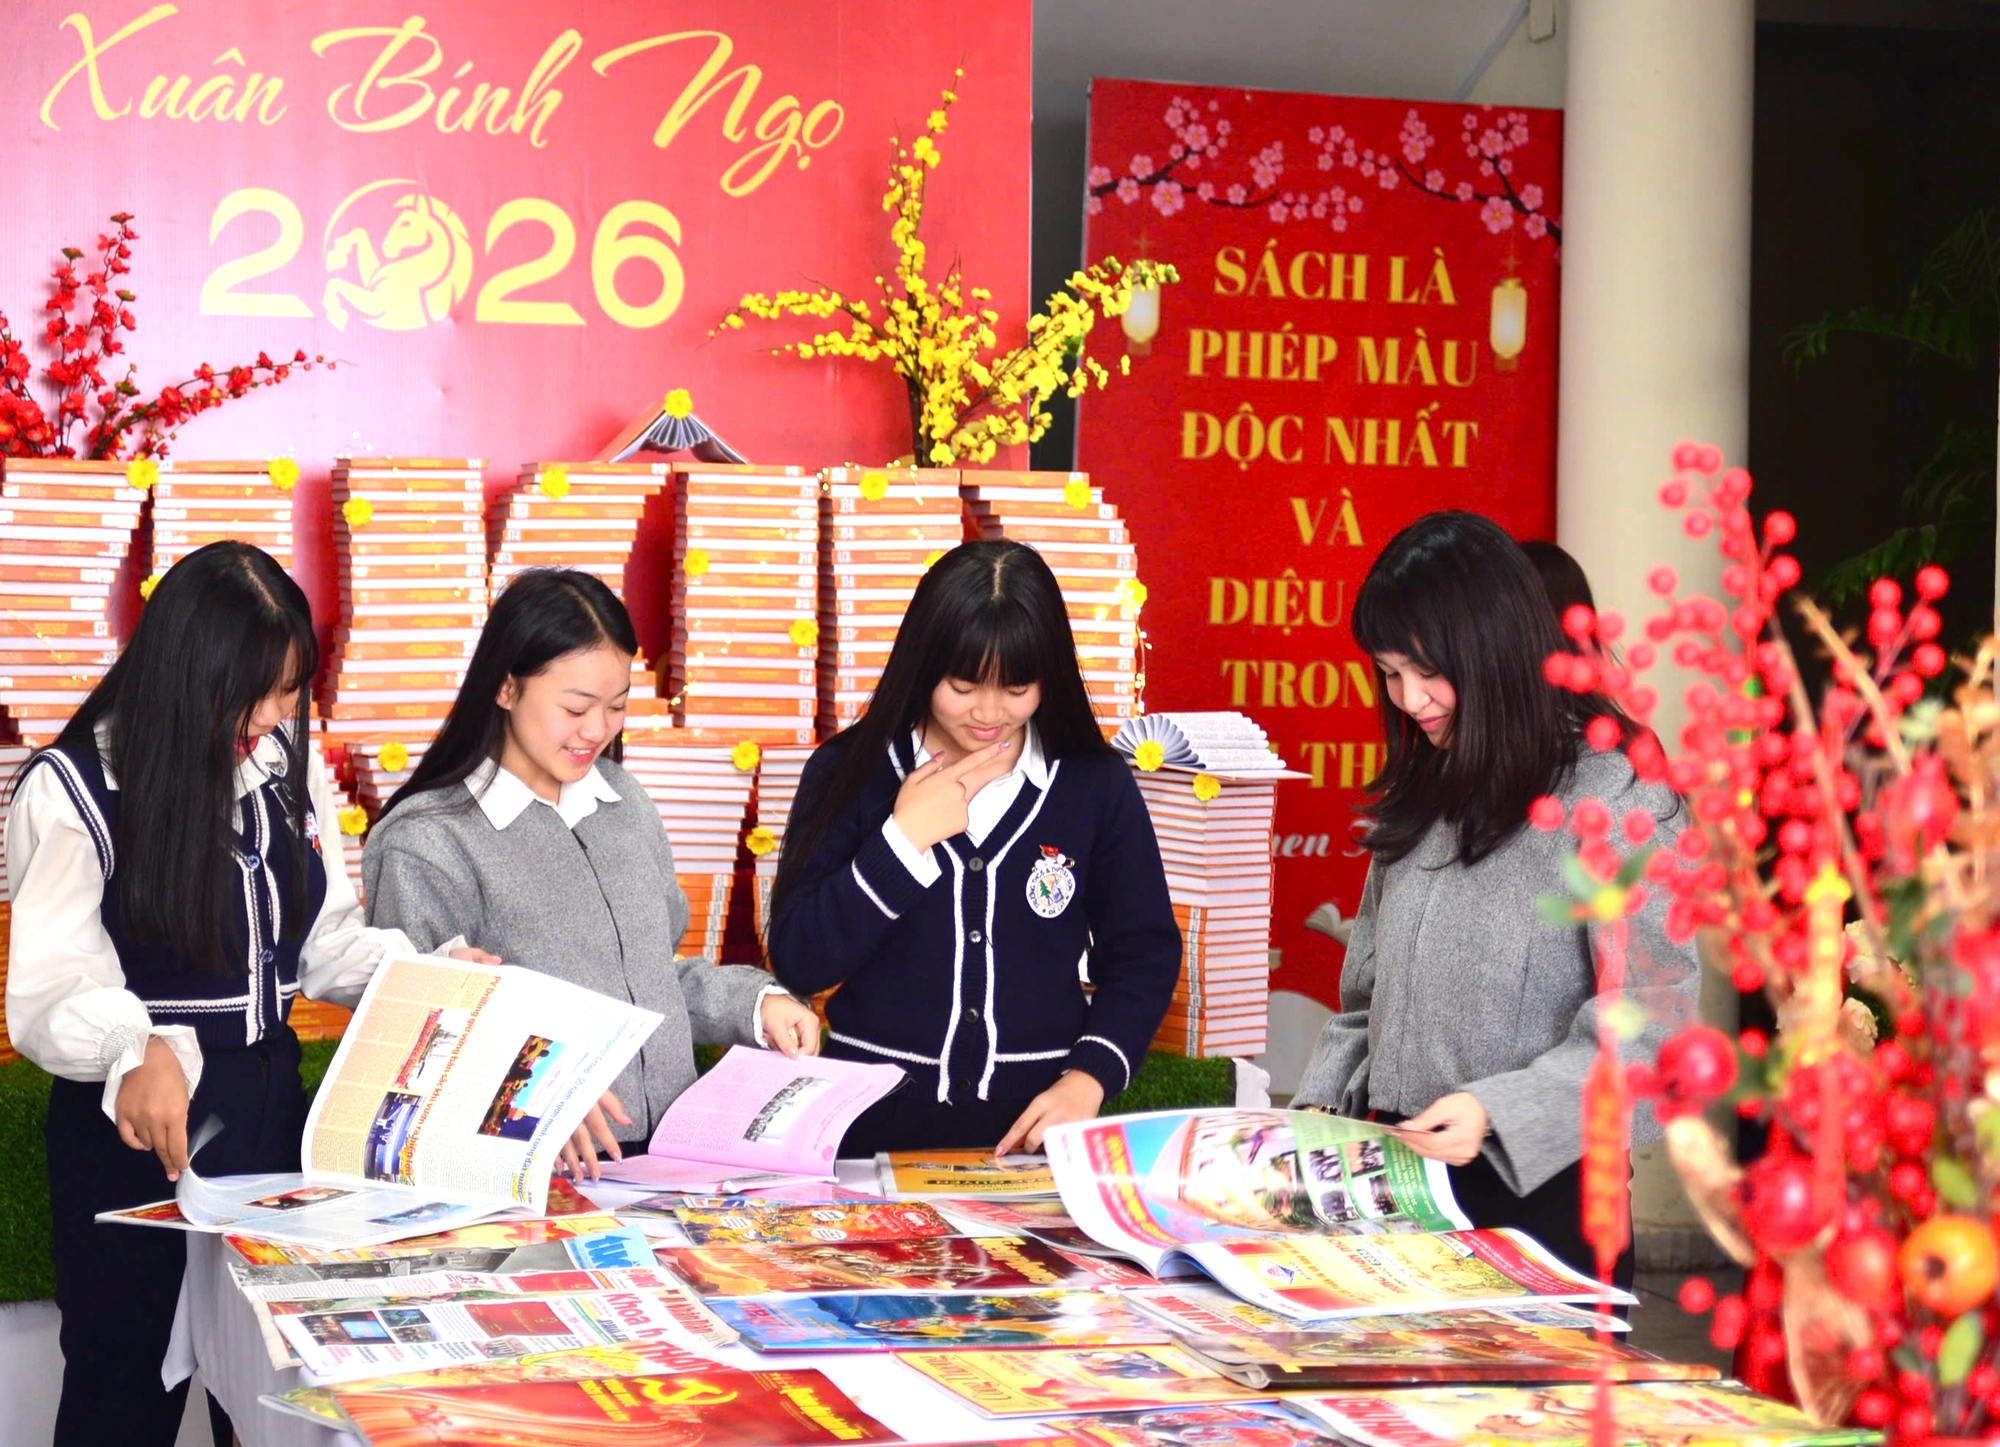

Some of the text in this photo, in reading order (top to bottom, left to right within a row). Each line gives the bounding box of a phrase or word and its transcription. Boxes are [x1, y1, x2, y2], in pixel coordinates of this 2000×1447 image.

[40, 3, 845, 197] Xuân Bính Ngọ
[1214, 238, 1457, 305] SÁCH LÀ
[1187, 321, 1479, 387] PHÉP MÀU
[1180, 402, 1480, 471] ĐỘC NHẤT
[1290, 488, 1364, 546] VÀ
[1207, 568, 1344, 636] DIỆU
[1221, 659, 1376, 709] TRON
[1300, 741, 1387, 789] TH
[470, 987, 495, 1018] Drilling
[602, 1293, 652, 1327] Khoa
